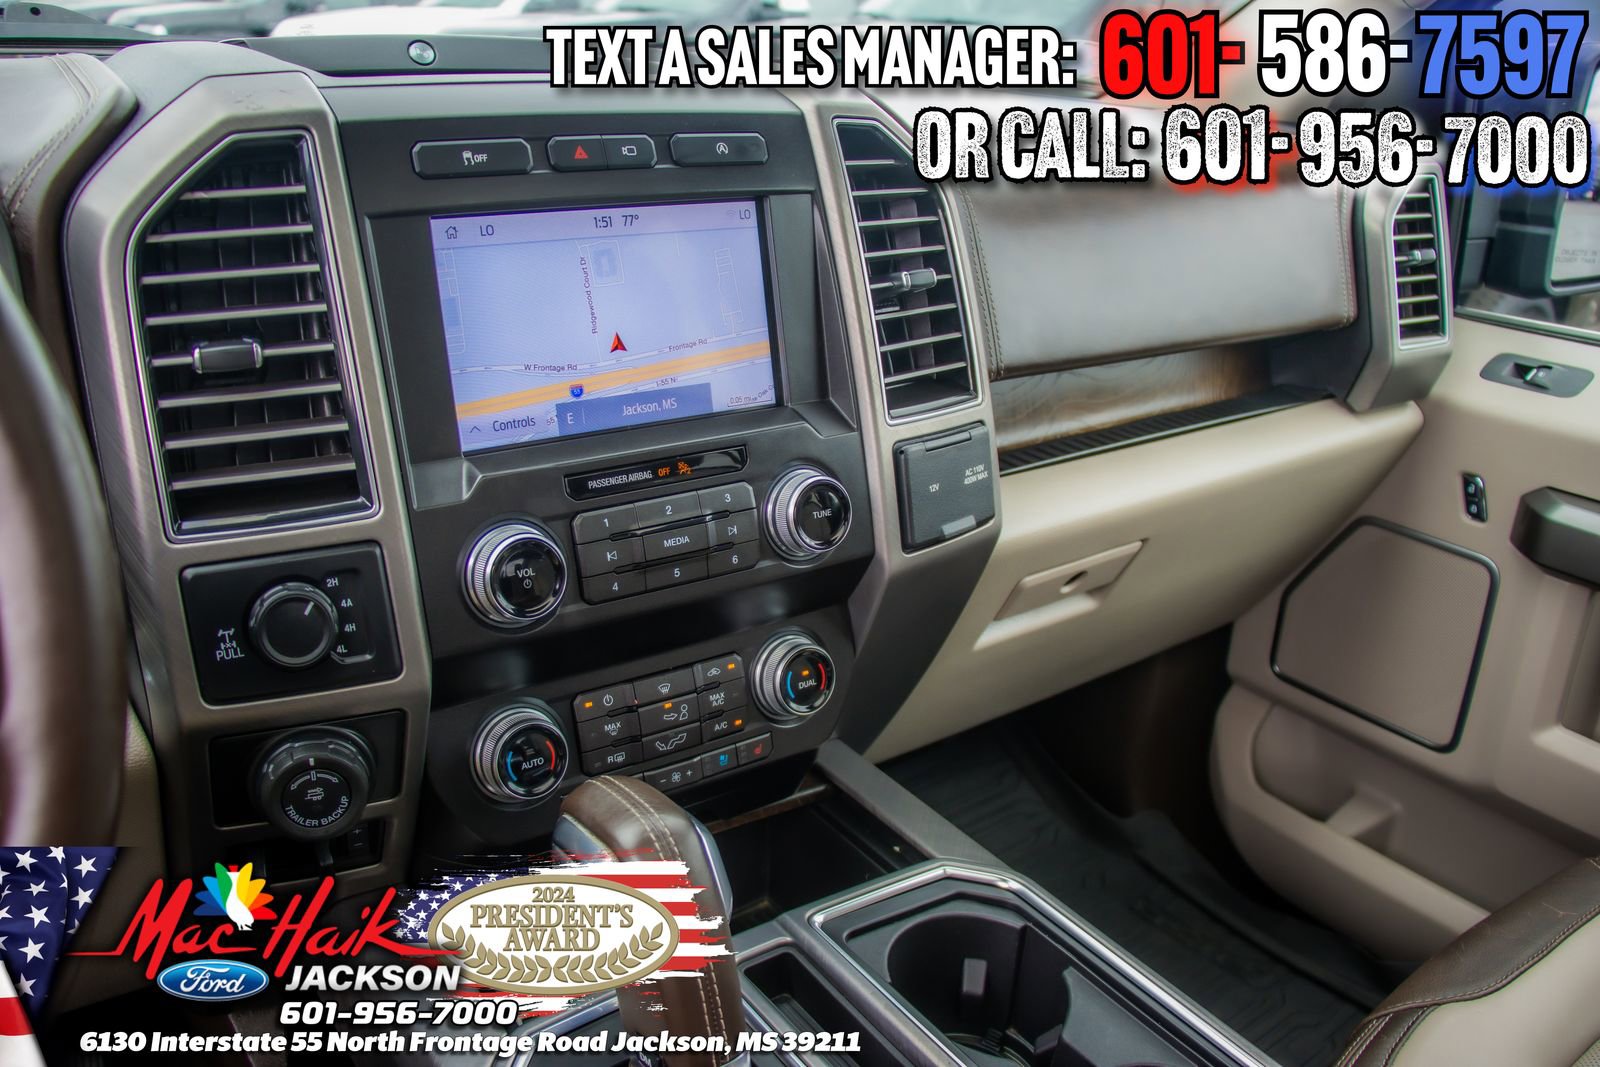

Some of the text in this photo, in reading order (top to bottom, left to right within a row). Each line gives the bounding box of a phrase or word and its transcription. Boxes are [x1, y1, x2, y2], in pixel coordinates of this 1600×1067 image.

[474, 153, 488, 163] OFF
[739, 208, 751, 220] LO
[593, 215, 613, 229] 1:51
[480, 224, 495, 237] LO
[580, 256, 598, 334] Ridgewood Court Dr
[668, 340, 697, 353] Frontage
[523, 363, 578, 373] W Frontage Rd
[622, 398, 678, 416] Jackson, MS
[492, 416, 536, 432] Controls
[567, 412, 574, 424] E
[588, 466, 671, 490] PASSENGER AIRBAG OFF
[929, 483, 940, 492] 12V
[724, 492, 732, 503] 3
[665, 505, 673, 515] 2
[812, 508, 832, 519] TUNE
[603, 517, 610, 528] 1
[663, 535, 691, 548] MEDIA
[731, 554, 739, 565] 6
[516, 567, 536, 579] VOL
[673, 567, 681, 578] 5
[325, 577, 339, 588] 2H
[611, 582, 619, 592] 4
[340, 598, 353, 608] 4A
[344, 623, 357, 633] 4H
[216, 648, 245, 662] PULL
[336, 644, 348, 654] 4L
[798, 678, 817, 690] DUAL
[708, 691, 726, 703] MAX
[712, 697, 725, 708] A/C
[604, 720, 622, 733] MAX
[714, 721, 728, 732] A/C
[520, 757, 545, 771] AUTO
[285, 795, 349, 827] TRAILER BACKUP
